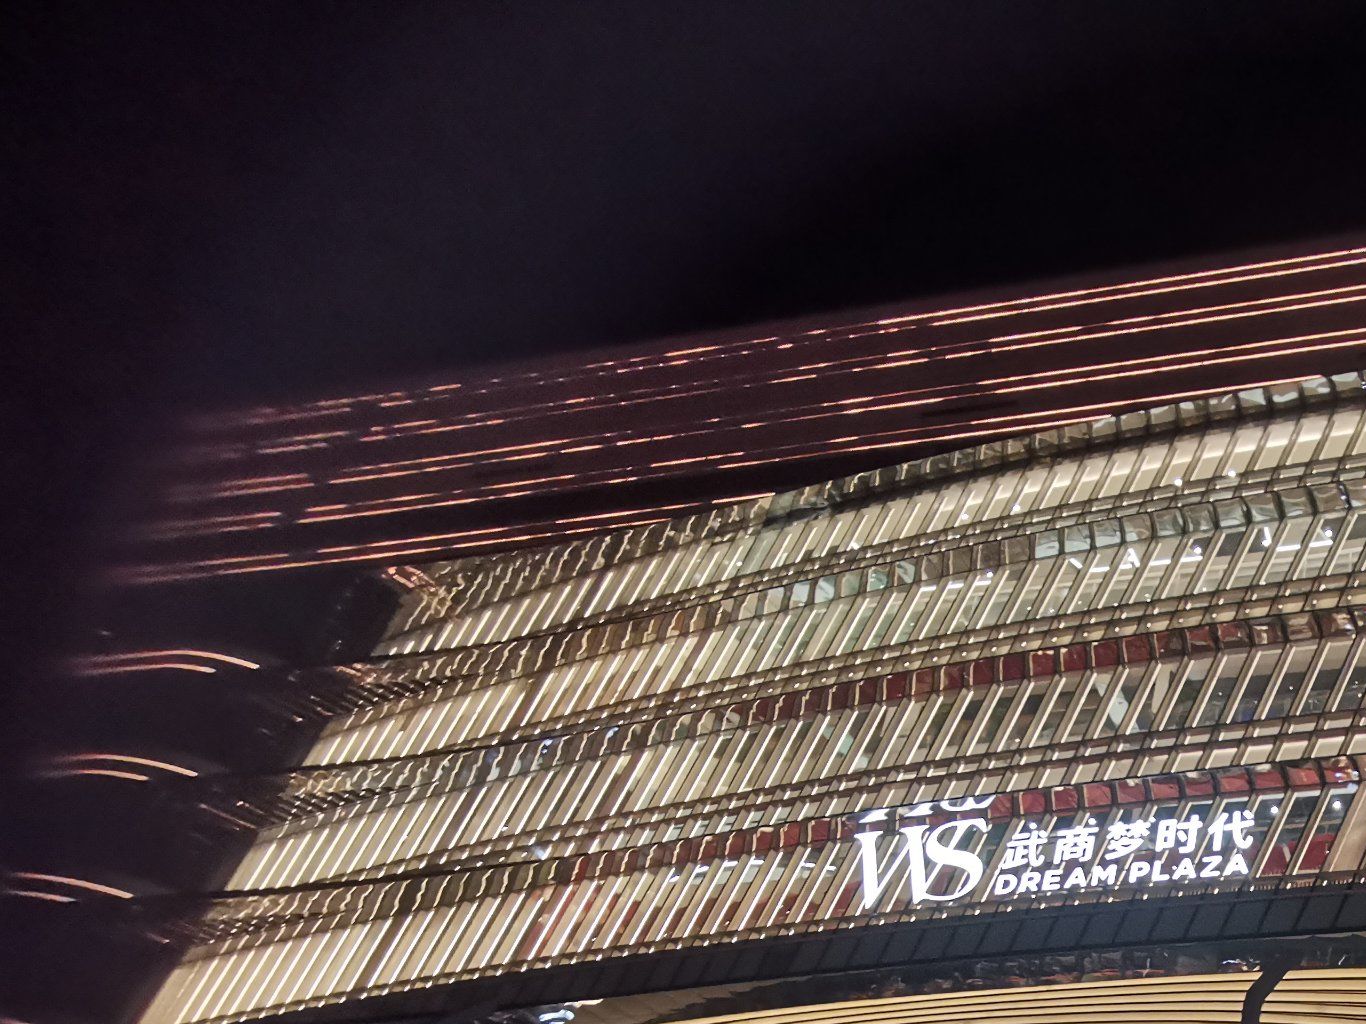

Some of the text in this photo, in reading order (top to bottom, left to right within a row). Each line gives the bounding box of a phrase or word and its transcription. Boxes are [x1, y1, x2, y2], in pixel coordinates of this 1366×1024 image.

[1004, 810, 1256, 870] 武商梦时代
[994, 855, 1249, 896] DREAM PLAZA
